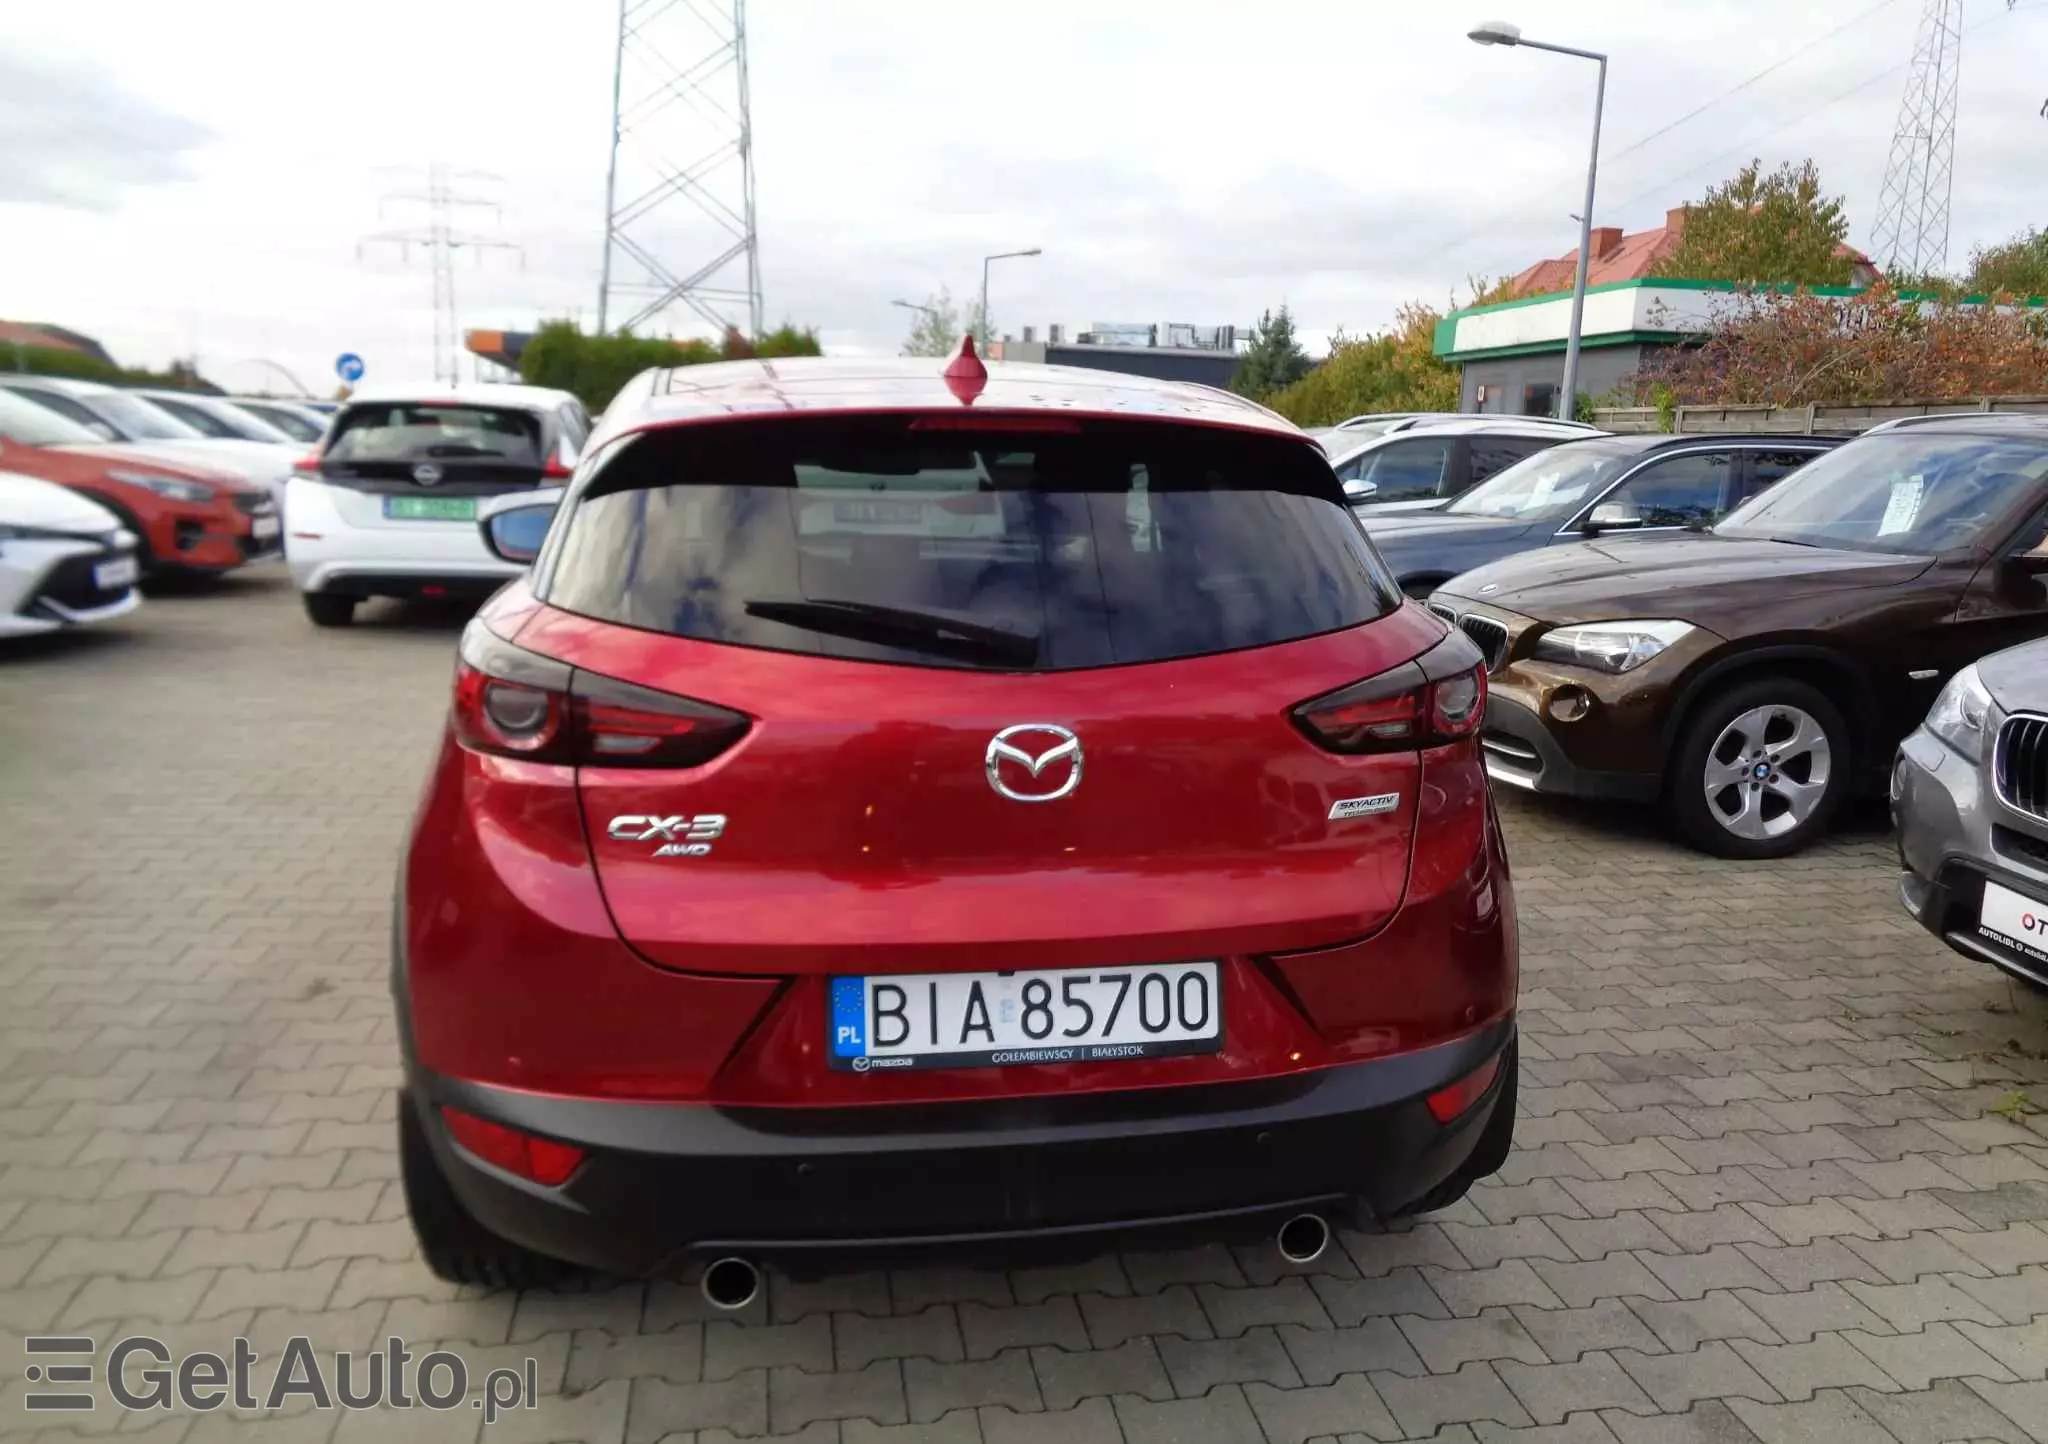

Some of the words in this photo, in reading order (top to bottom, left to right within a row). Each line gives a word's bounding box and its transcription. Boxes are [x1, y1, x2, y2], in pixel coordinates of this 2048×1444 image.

[1339, 796, 1396, 809] SKYACTIV
[607, 813, 728, 840] CX-3
[651, 843, 712, 857] AWD
[871, 980, 996, 1047] BIA
[1020, 971, 1209, 1040] 85700
[838, 1027, 861, 1044] PL
[872, 1058, 913, 1068] mazda
